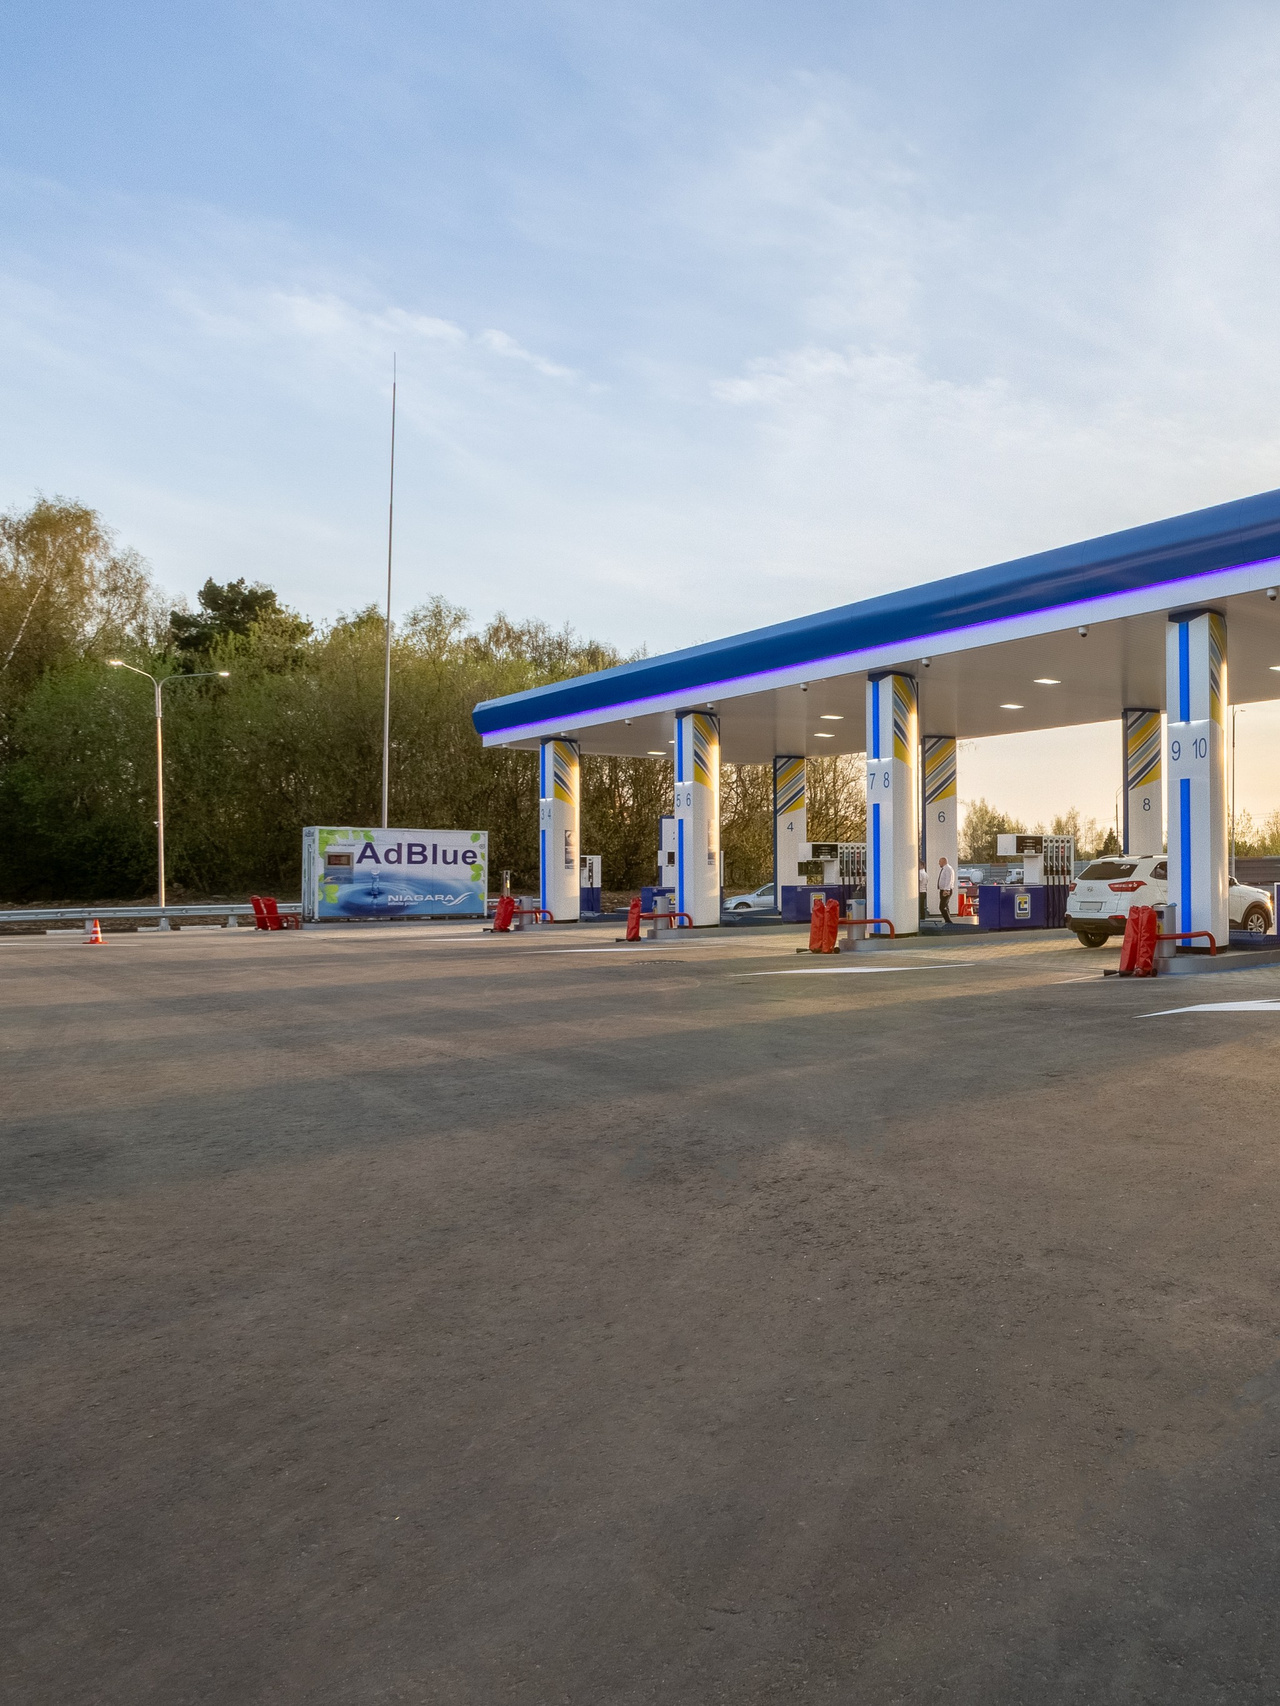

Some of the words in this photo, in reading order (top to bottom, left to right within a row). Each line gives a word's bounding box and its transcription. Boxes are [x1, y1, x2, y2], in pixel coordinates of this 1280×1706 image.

[1171, 740, 1180, 761] 9
[1192, 737, 1207, 759] 10
[869, 773, 876, 790] 7
[883, 771, 890, 788] 8
[676, 793, 681, 807] 5
[686, 793, 691, 806] 6
[1142, 797, 1151, 811] 8
[937, 811, 946, 823] 6
[786, 822, 794, 831] 4
[356, 842, 478, 866] AdBlue
[387, 894, 455, 902] NIAGARA
